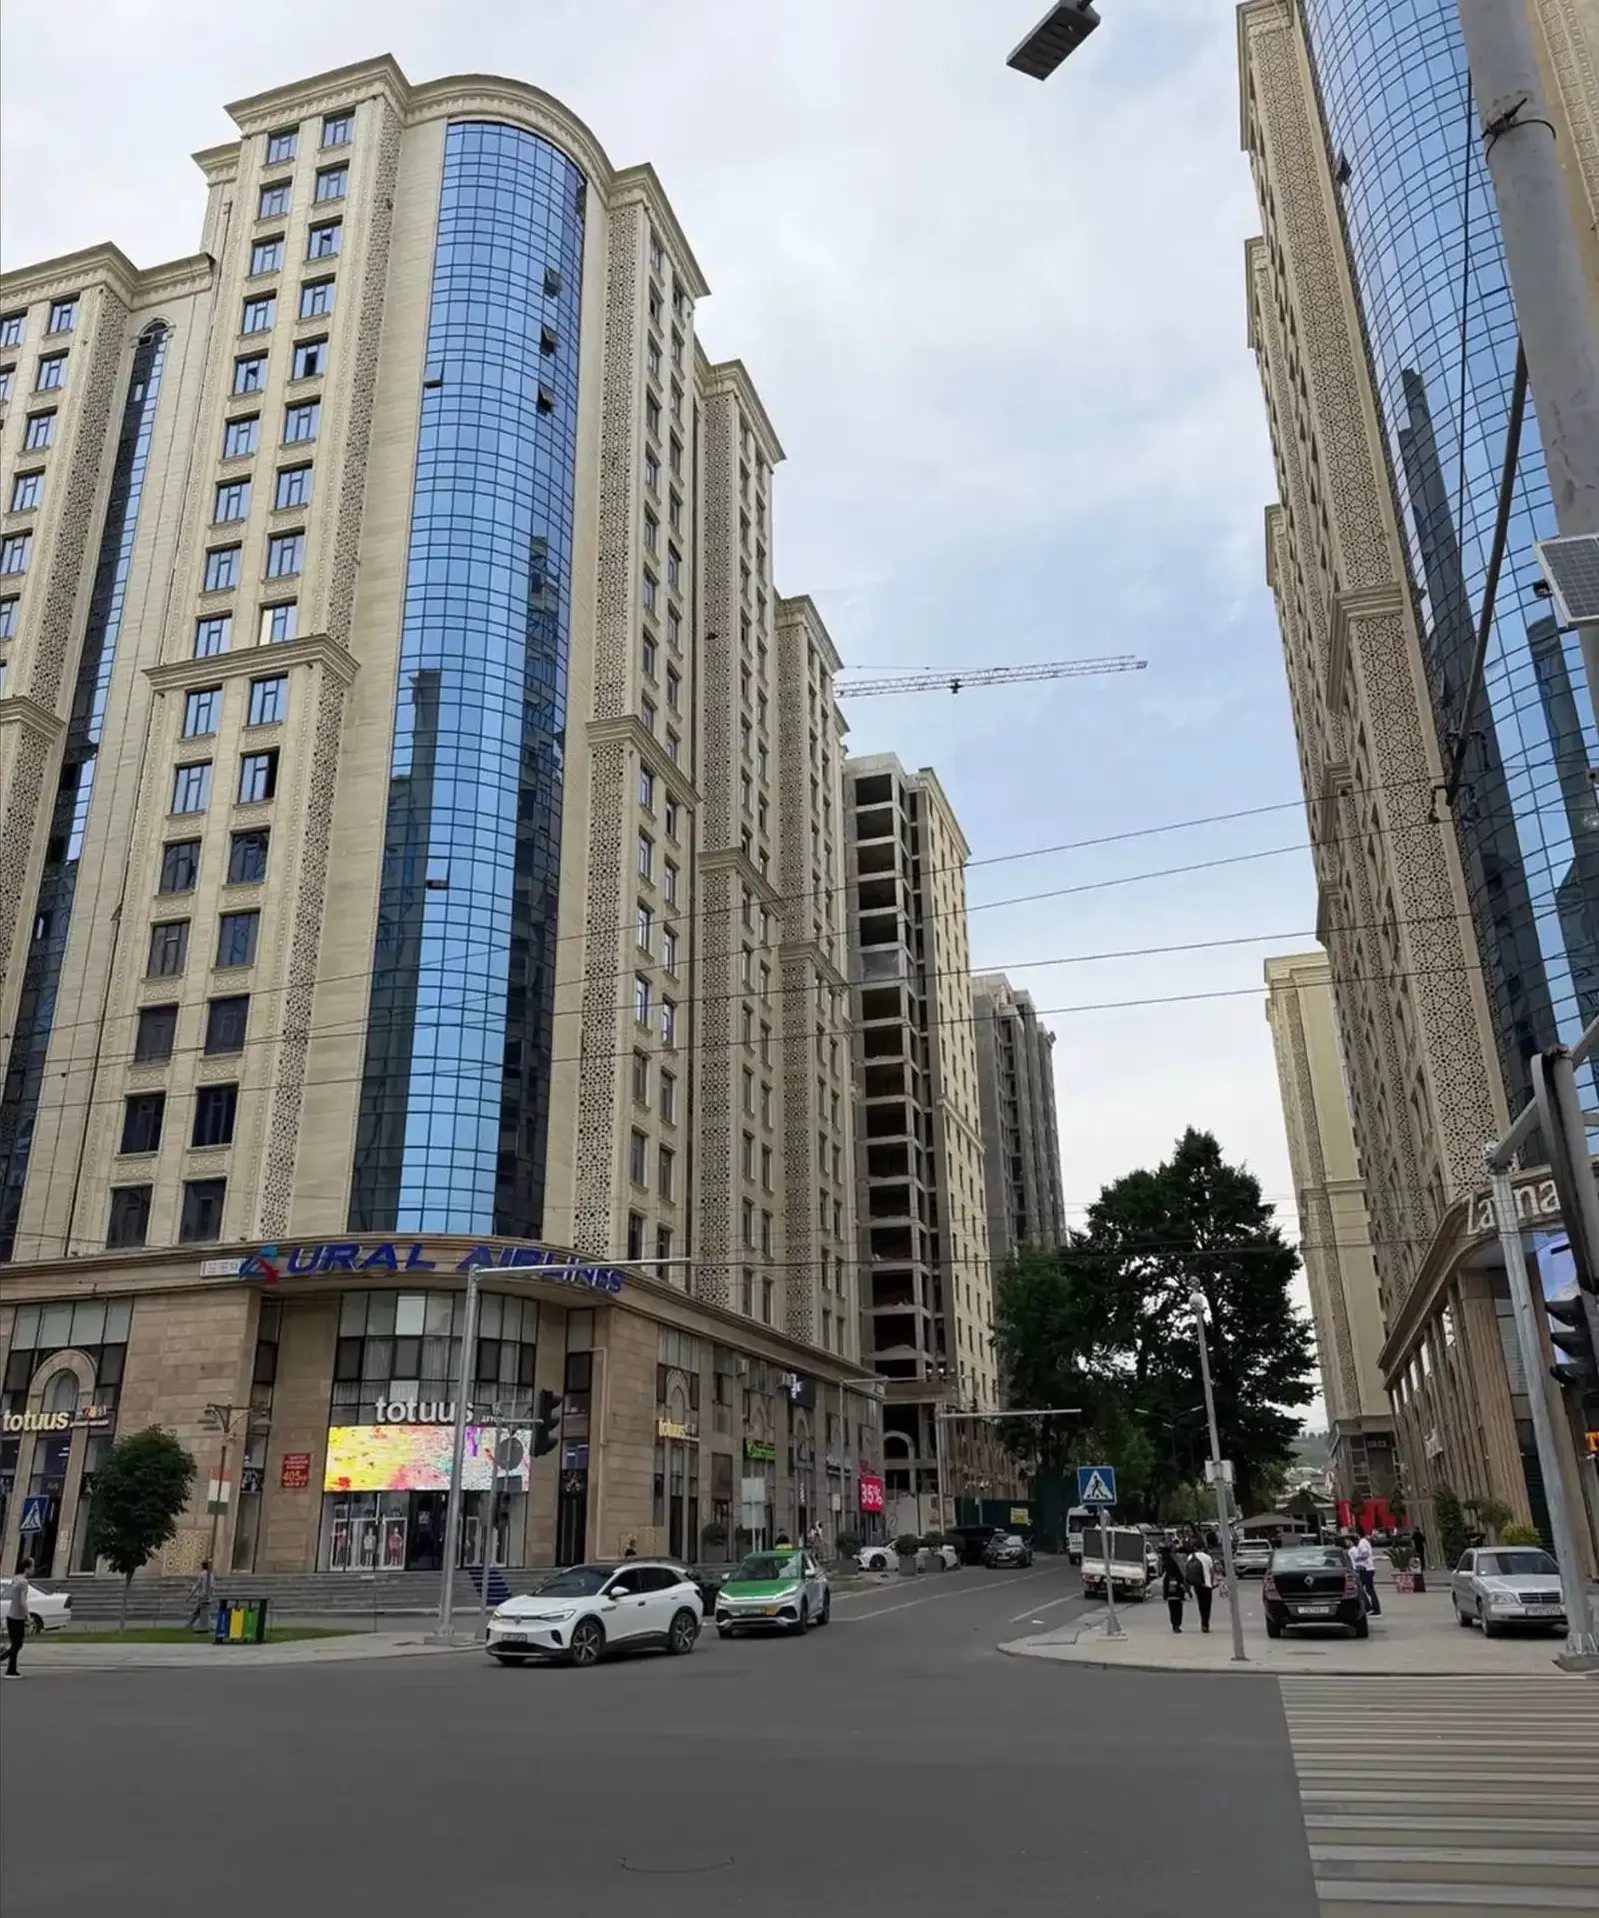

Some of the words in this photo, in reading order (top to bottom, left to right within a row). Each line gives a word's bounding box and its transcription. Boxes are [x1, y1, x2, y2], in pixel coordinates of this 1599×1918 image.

[287, 1243, 436, 1273] URAL
[3, 1409, 70, 1432] totuus
[375, 1395, 474, 1423] totuus
[861, 1483, 883, 1505] 35%
